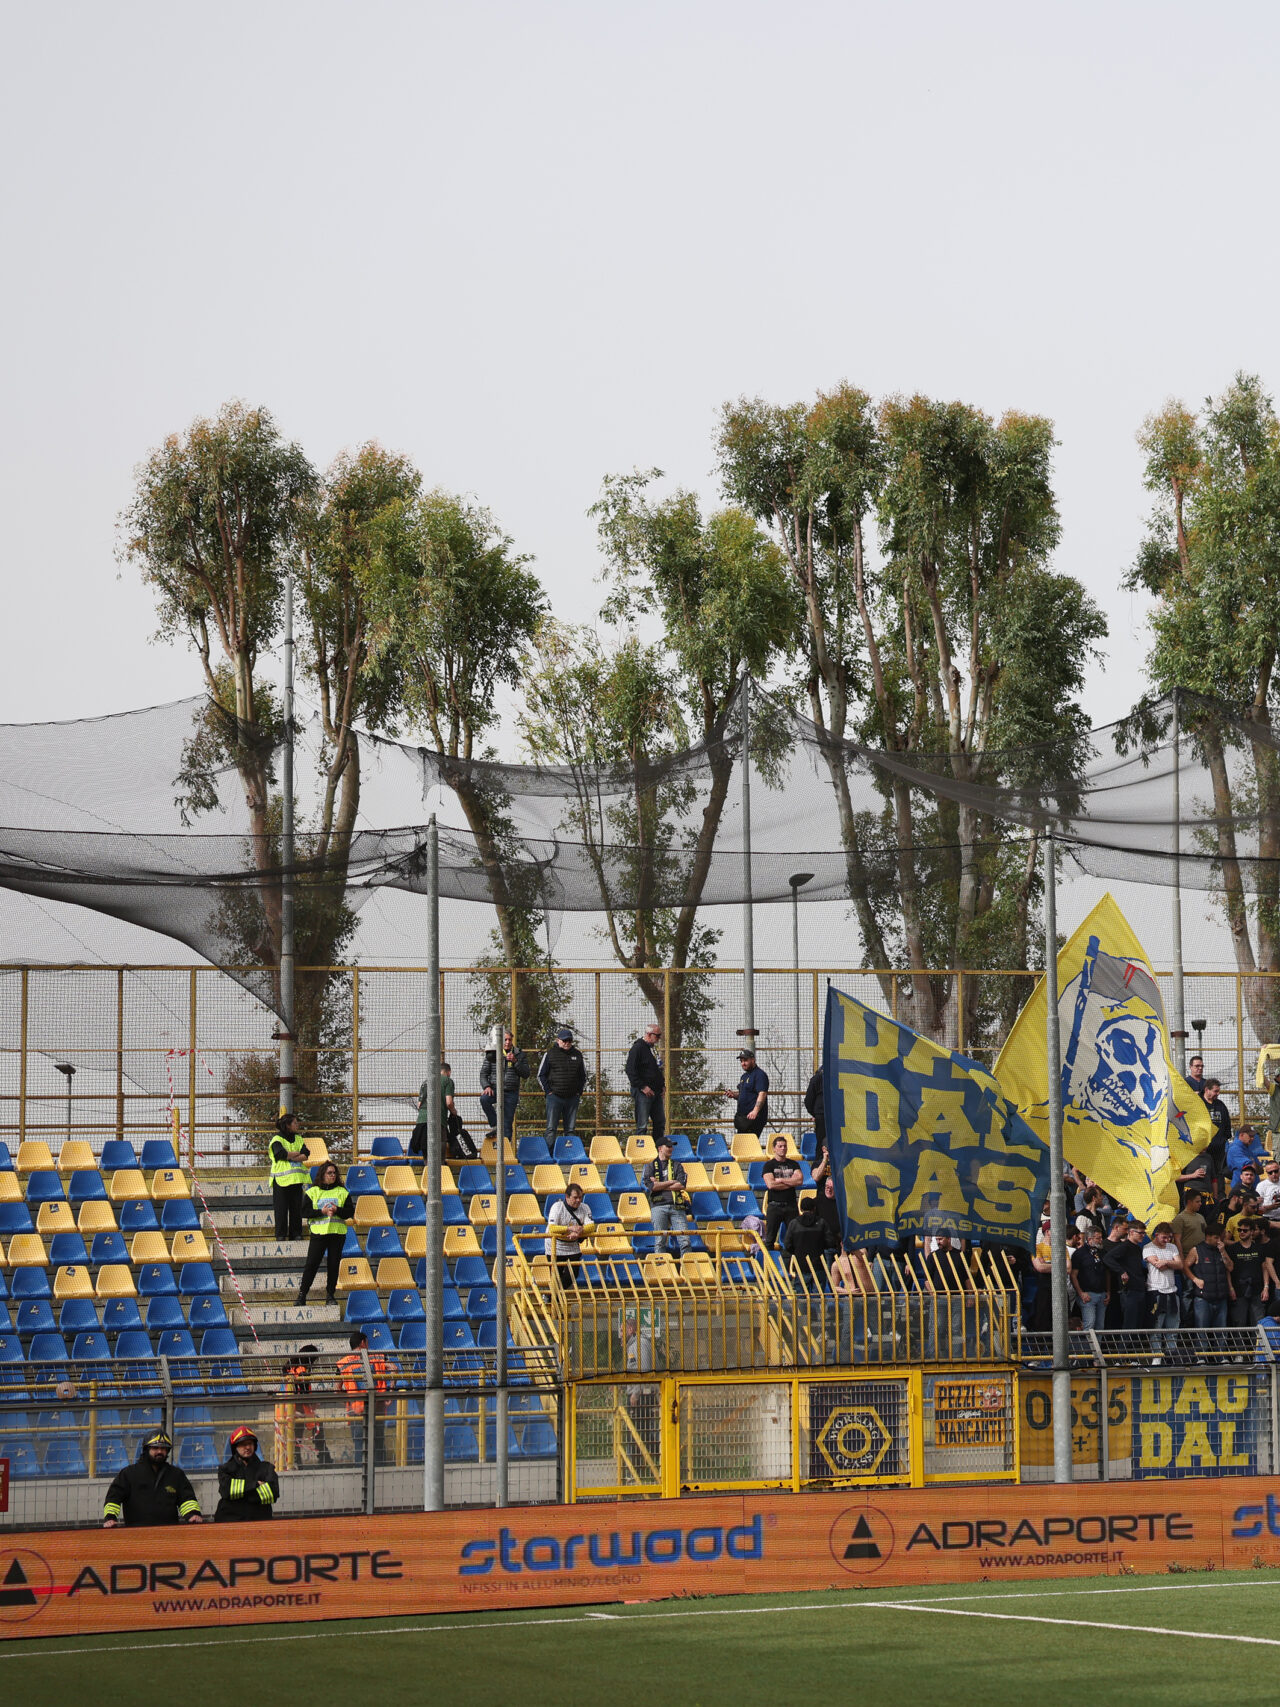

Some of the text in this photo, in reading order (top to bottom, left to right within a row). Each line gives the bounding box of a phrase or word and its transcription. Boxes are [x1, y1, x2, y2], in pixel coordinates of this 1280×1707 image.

[224, 1184, 264, 1195] FILA
[842, 1149, 1037, 1225] GAS
[233, 1214, 273, 1226] FILA
[884, 1216, 924, 1242] BON
[927, 1216, 1032, 1243] PASTORE
[243, 1245, 283, 1257] FILA
[253, 1277, 295, 1290] FILA
[263, 1310, 304, 1322] FILA
[938, 1385, 976, 1409] PEZZI
[1139, 1374, 1249, 1414] DAG
[829, 1414, 880, 1440] WORKING
[938, 1420, 1002, 1444] MANCANTI
[1139, 1421, 1249, 1468] DAL
[835, 1451, 874, 1470] CLASS
[905, 1512, 1194, 1552] ADRAPORTE
[459, 1514, 764, 1576] starwood
[979, 1550, 1125, 1568] WWW.ADRAPORTE.IT
[67, 1550, 404, 1598] ADRAPORTE
[152, 1592, 322, 1614] WWW.ADRAPORTE.IT
